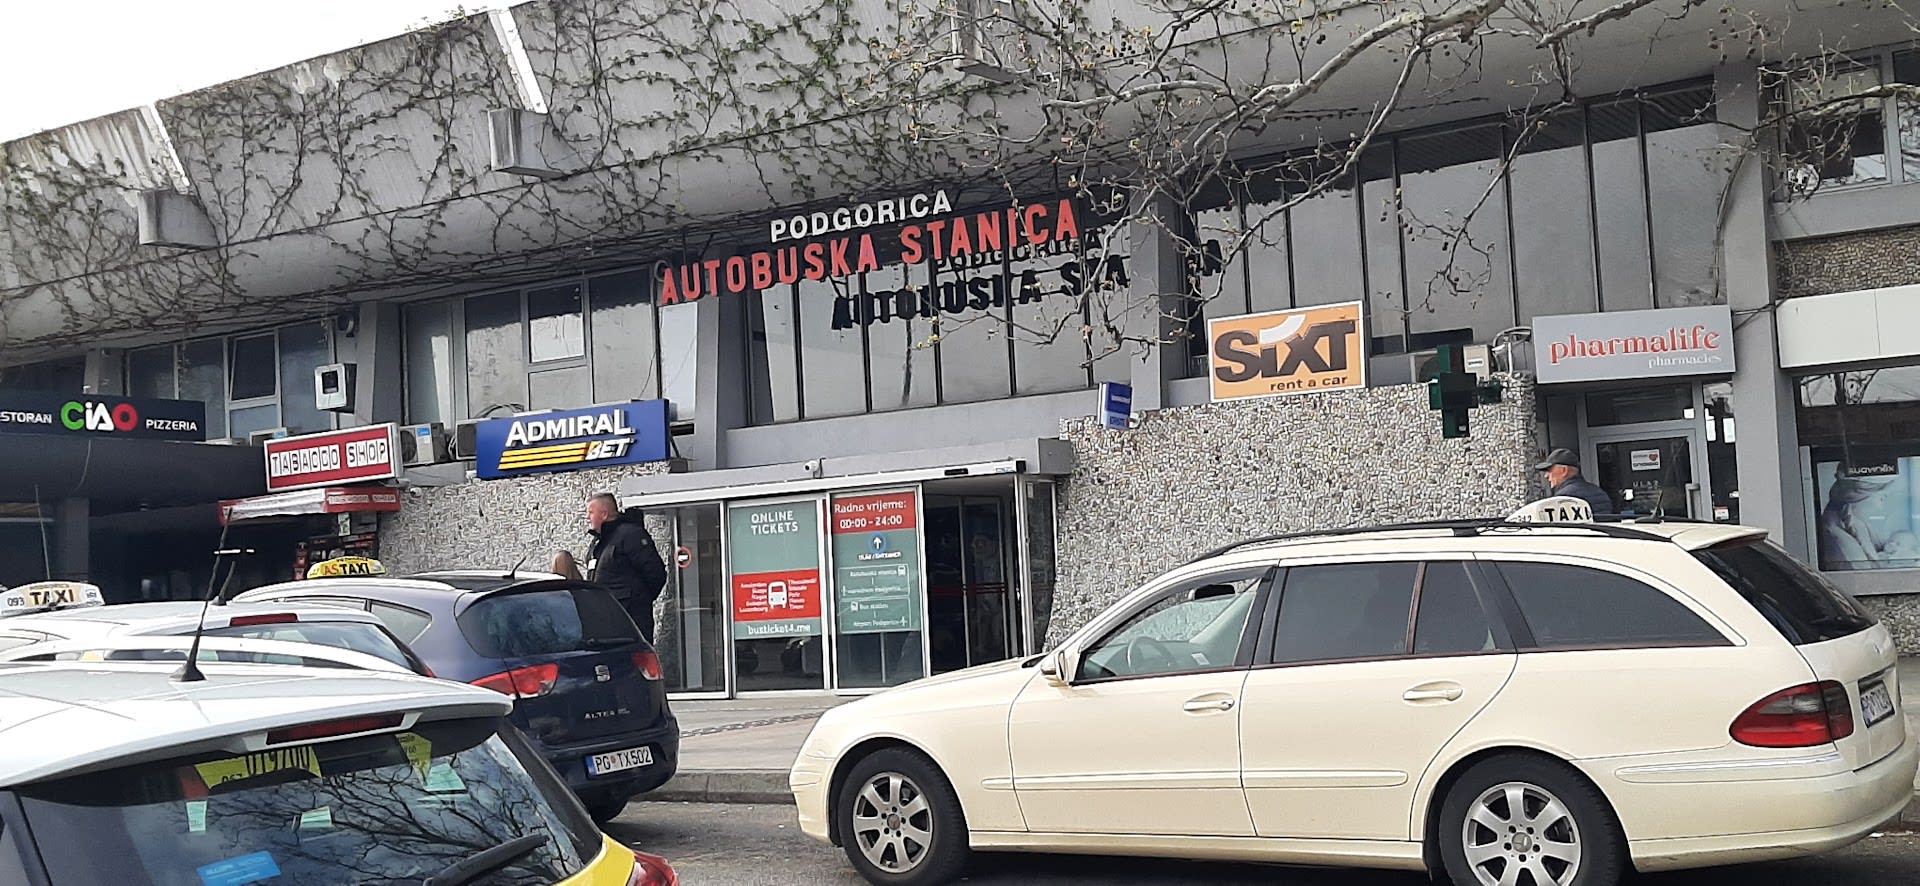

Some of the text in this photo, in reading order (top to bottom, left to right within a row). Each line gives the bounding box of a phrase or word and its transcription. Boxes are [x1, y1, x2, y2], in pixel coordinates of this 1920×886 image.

[770, 190, 952, 243] PODGORICA
[661, 199, 1079, 305] AUTOBUSKA STANICA
[1550, 324, 1720, 363] pharmalife
[1648, 355, 1722, 369] pharmacies
[1270, 375, 1348, 391] rent a car
[146, 419, 197, 431] PIZZERIA
[506, 409, 634, 447] ADMIRAL
[586, 438, 631, 460] BET
[272, 442, 386, 475] TABACCO SHOP
[834, 501, 907, 513] Radno vrijeme:
[1544, 507, 1591, 522] TAXI
[751, 511, 793, 523] ONLINE
[840, 518, 867, 529] 00:00
[875, 515, 902, 526] 24:00
[751, 522, 798, 535] TICKETS
[30, 589, 75, 605] TAXI
[595, 749, 651, 772] PG TX502
